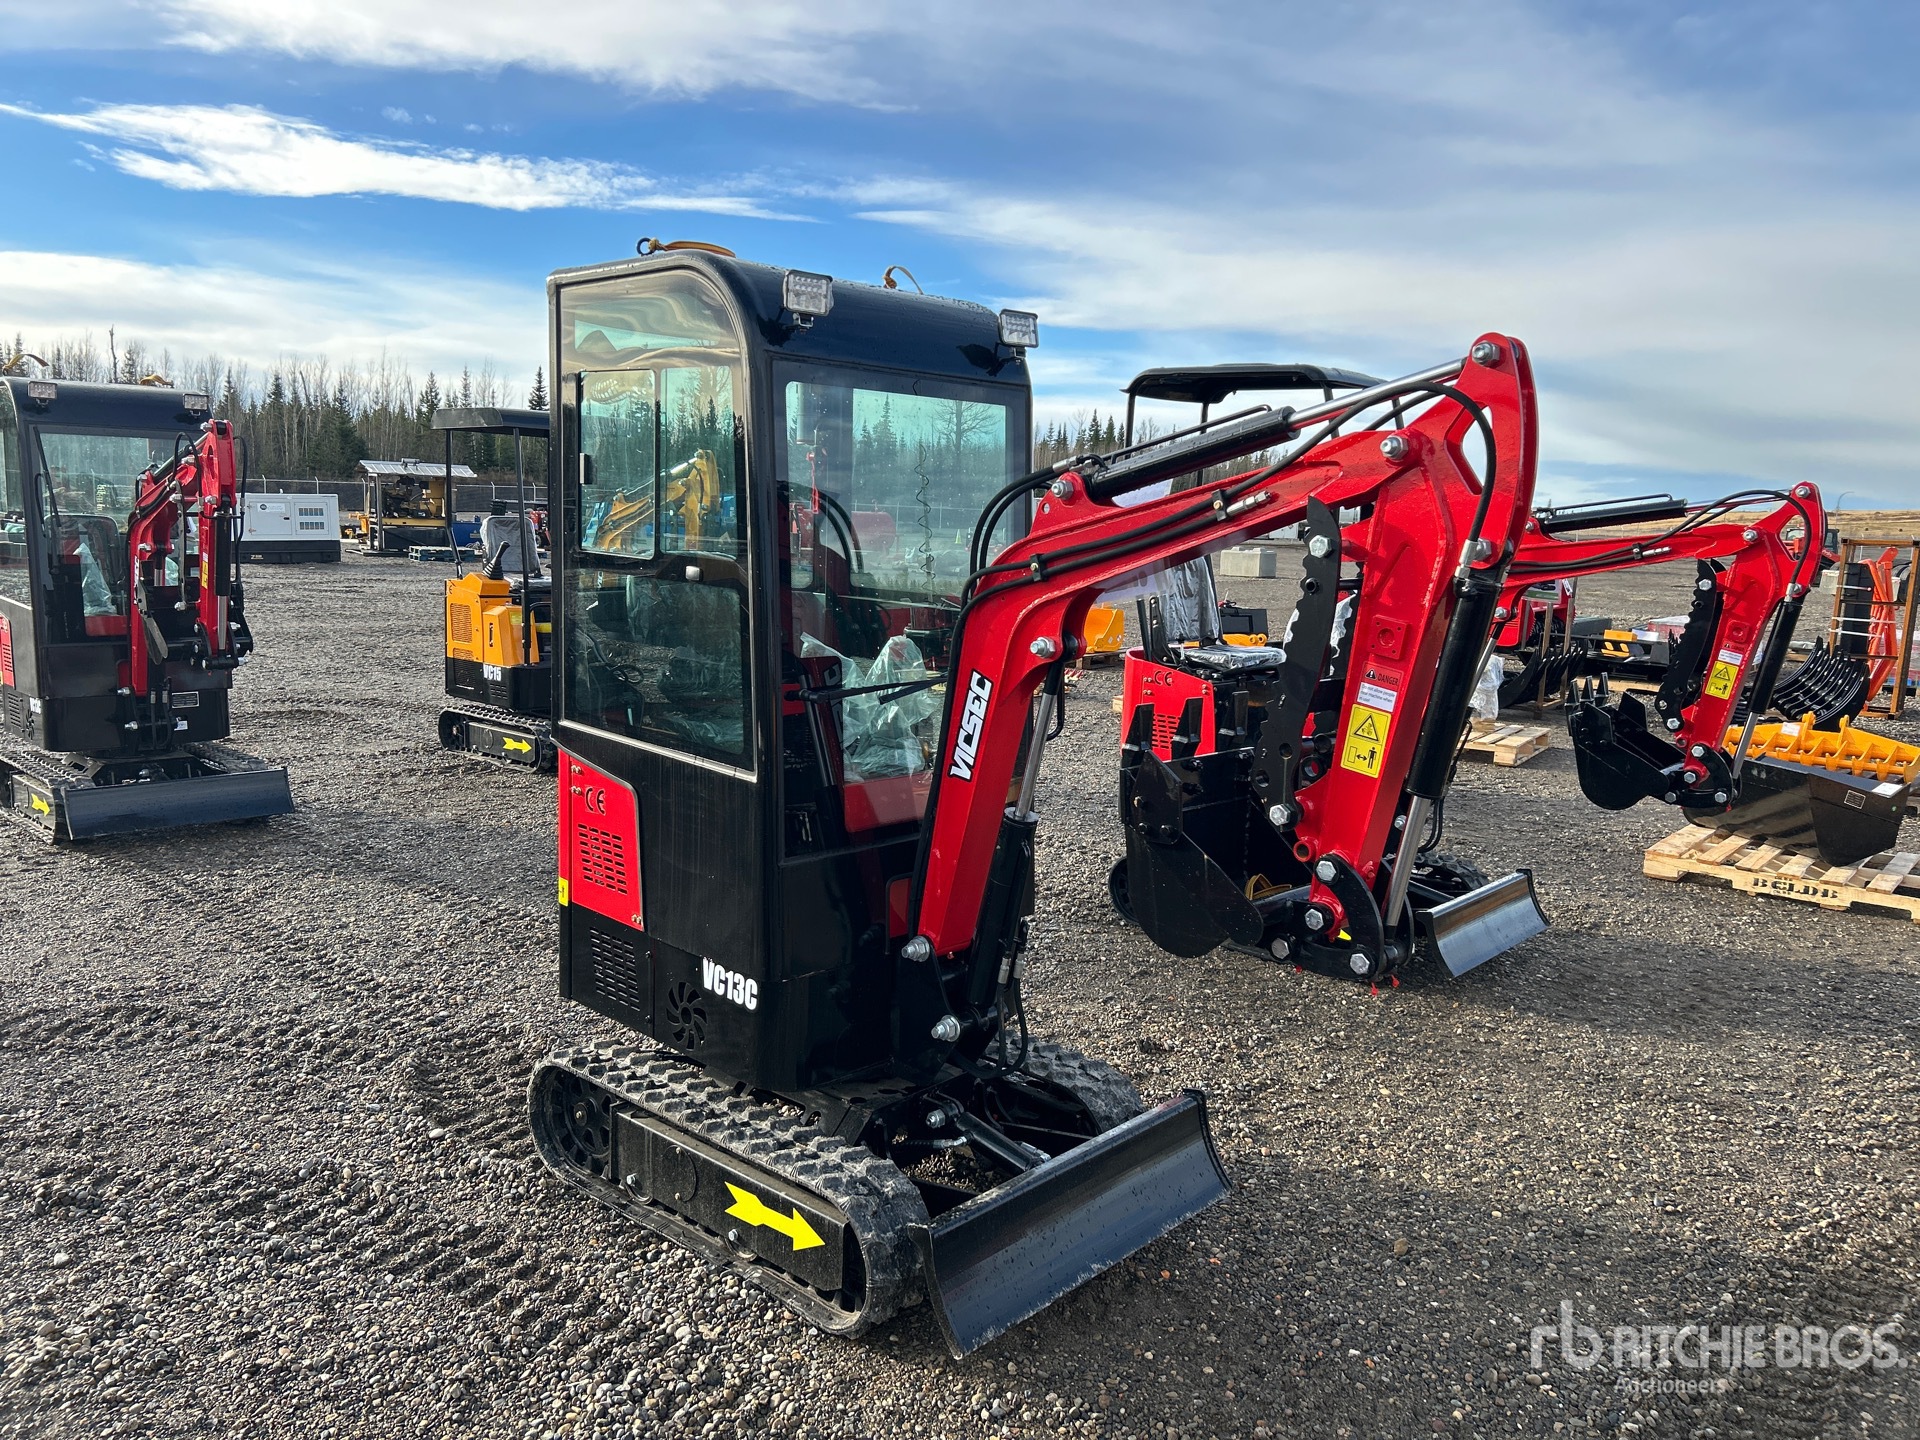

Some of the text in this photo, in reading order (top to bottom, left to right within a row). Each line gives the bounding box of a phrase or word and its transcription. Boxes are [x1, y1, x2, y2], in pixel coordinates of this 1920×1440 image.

[483, 664, 502, 681] VC15
[1378, 674, 1398, 686] DANGER
[949, 670, 993, 781] VICSEC
[703, 957, 758, 1010] VC13C
